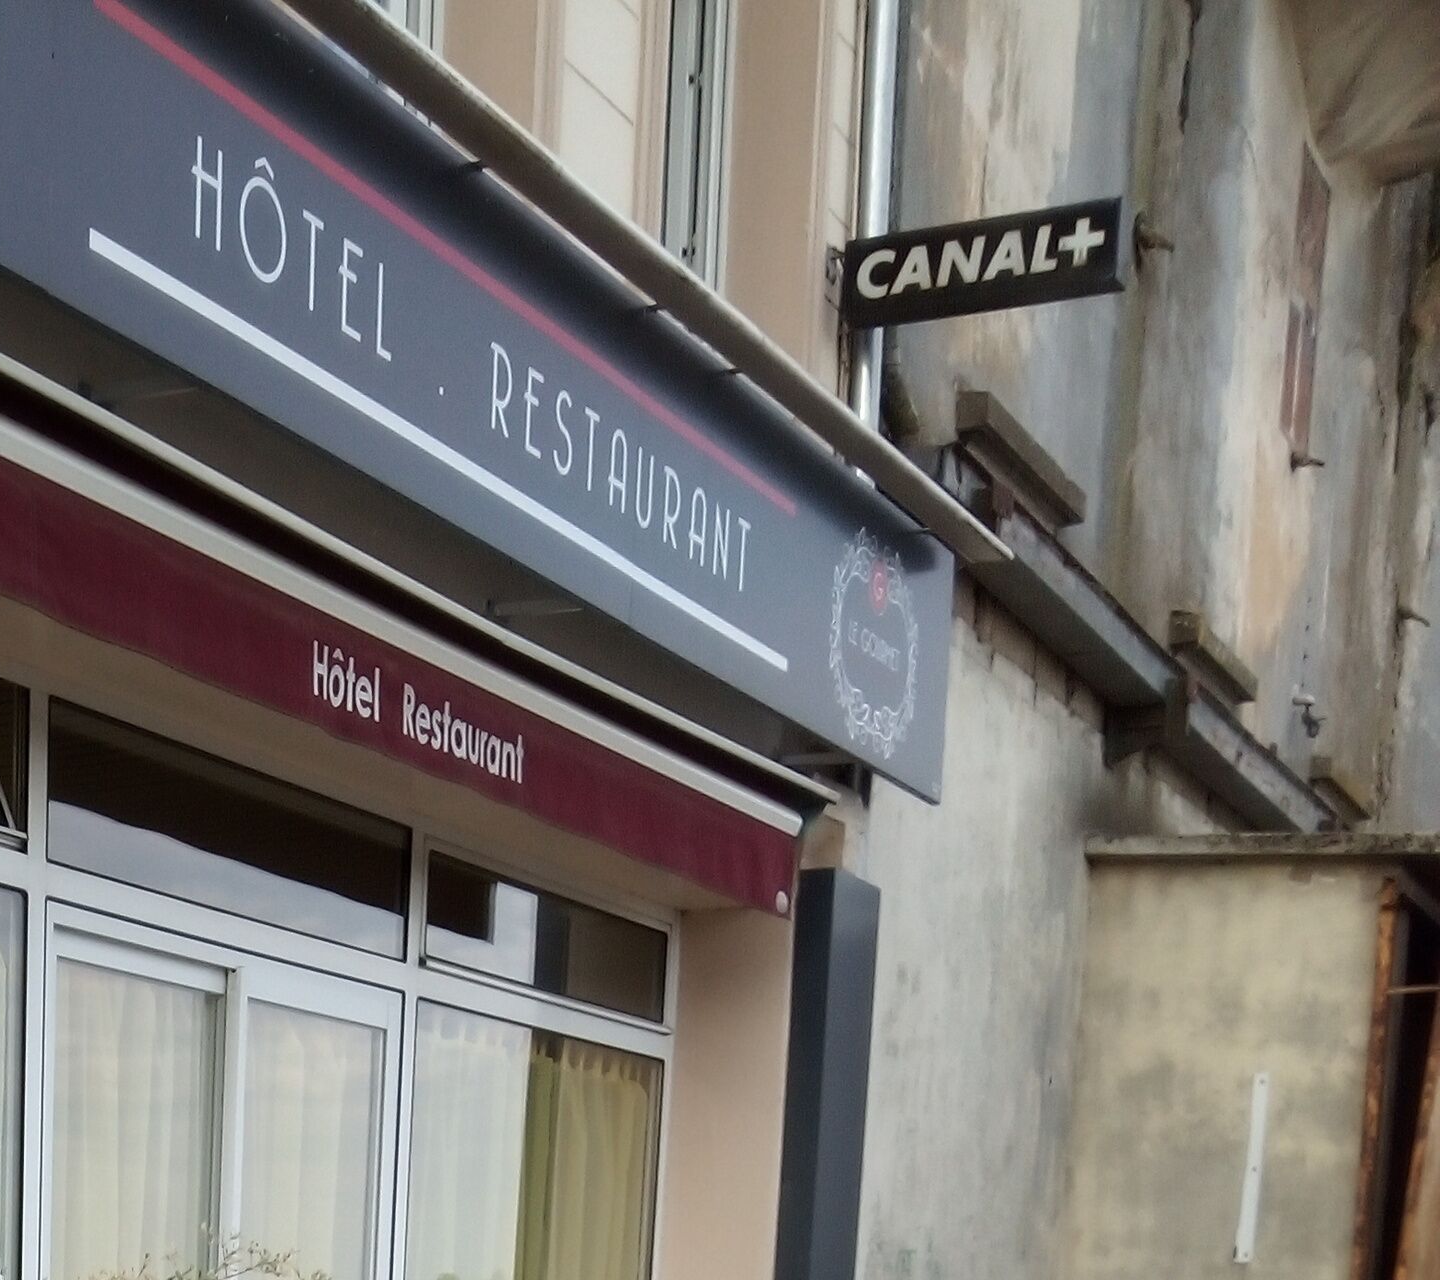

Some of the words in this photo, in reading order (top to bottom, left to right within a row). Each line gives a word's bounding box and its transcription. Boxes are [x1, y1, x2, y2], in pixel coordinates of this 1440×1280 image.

[856, 216, 1106, 300] CANAL+
[191, 135, 392, 362] HÔTEL
[490, 341, 752, 592] RESTAURANT
[312, 639, 380, 722] Hôtel
[402, 683, 525, 783] Restaurant
